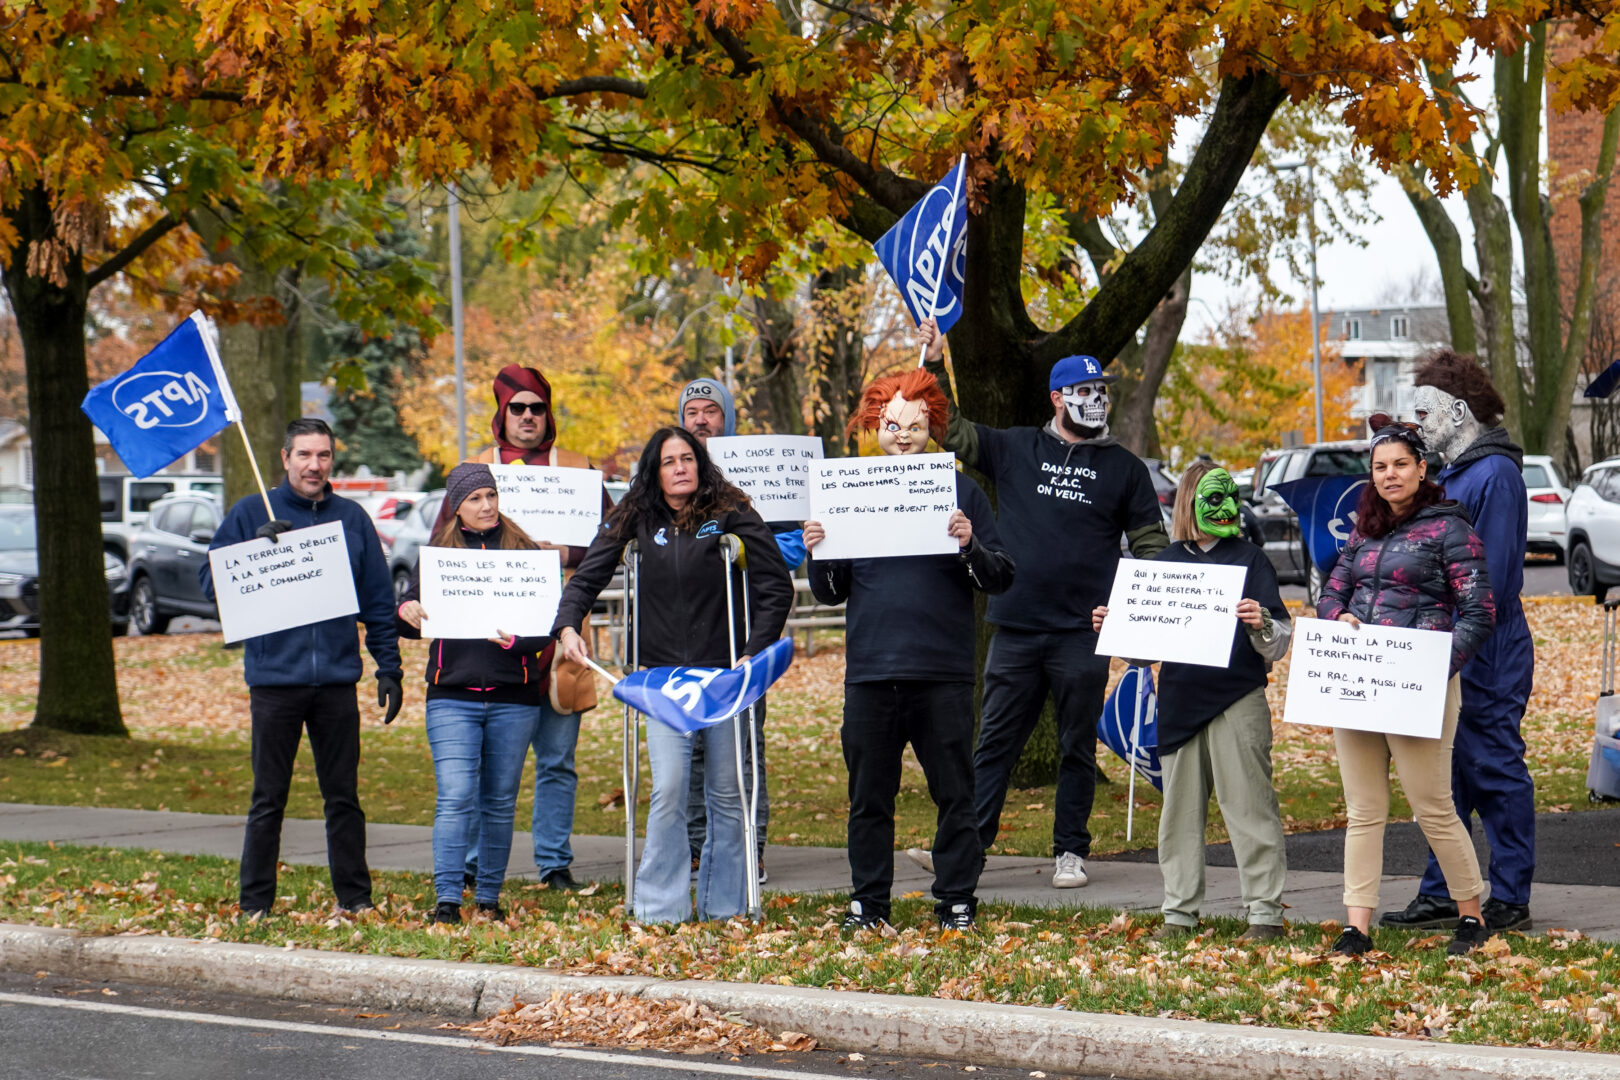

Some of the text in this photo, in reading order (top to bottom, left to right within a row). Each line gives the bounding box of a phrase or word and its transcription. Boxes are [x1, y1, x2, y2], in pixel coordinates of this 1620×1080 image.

[1083, 359, 1097, 373] LA
[687, 386, 711, 396] D&G
[746, 448, 775, 457] CHOSE
[782, 449, 795, 457] EST
[802, 450, 813, 458] UN
[868, 463, 925, 474] EFFRAYANT
[930, 462, 953, 470] DANS
[1041, 462, 1097, 480] DANS NOS
[786, 477, 805, 486] ÊTRE
[822, 482, 836, 490] LES
[909, 486, 952, 494] EMPLOYÉES
[1037, 484, 1091, 504] ON VEUT...
[894, 504, 928, 512] RÊVENT
[226, 535, 339, 569] LA TERREUR DÉBUTE
[242, 571, 253, 579] LA
[259, 559, 296, 574] SECONDE
[438, 560, 467, 568] DANS
[240, 569, 323, 594] CELA COMMENCE
[441, 575, 492, 583] PERSONNE
[1181, 602, 1207, 610] CELLES
[1306, 632, 1323, 642] LA
[1332, 635, 1357, 645] NUIT
[1386, 640, 1412, 650] PLUS
[1371, 679, 1396, 687] AUSSI
[1340, 688, 1366, 698] JOUR
